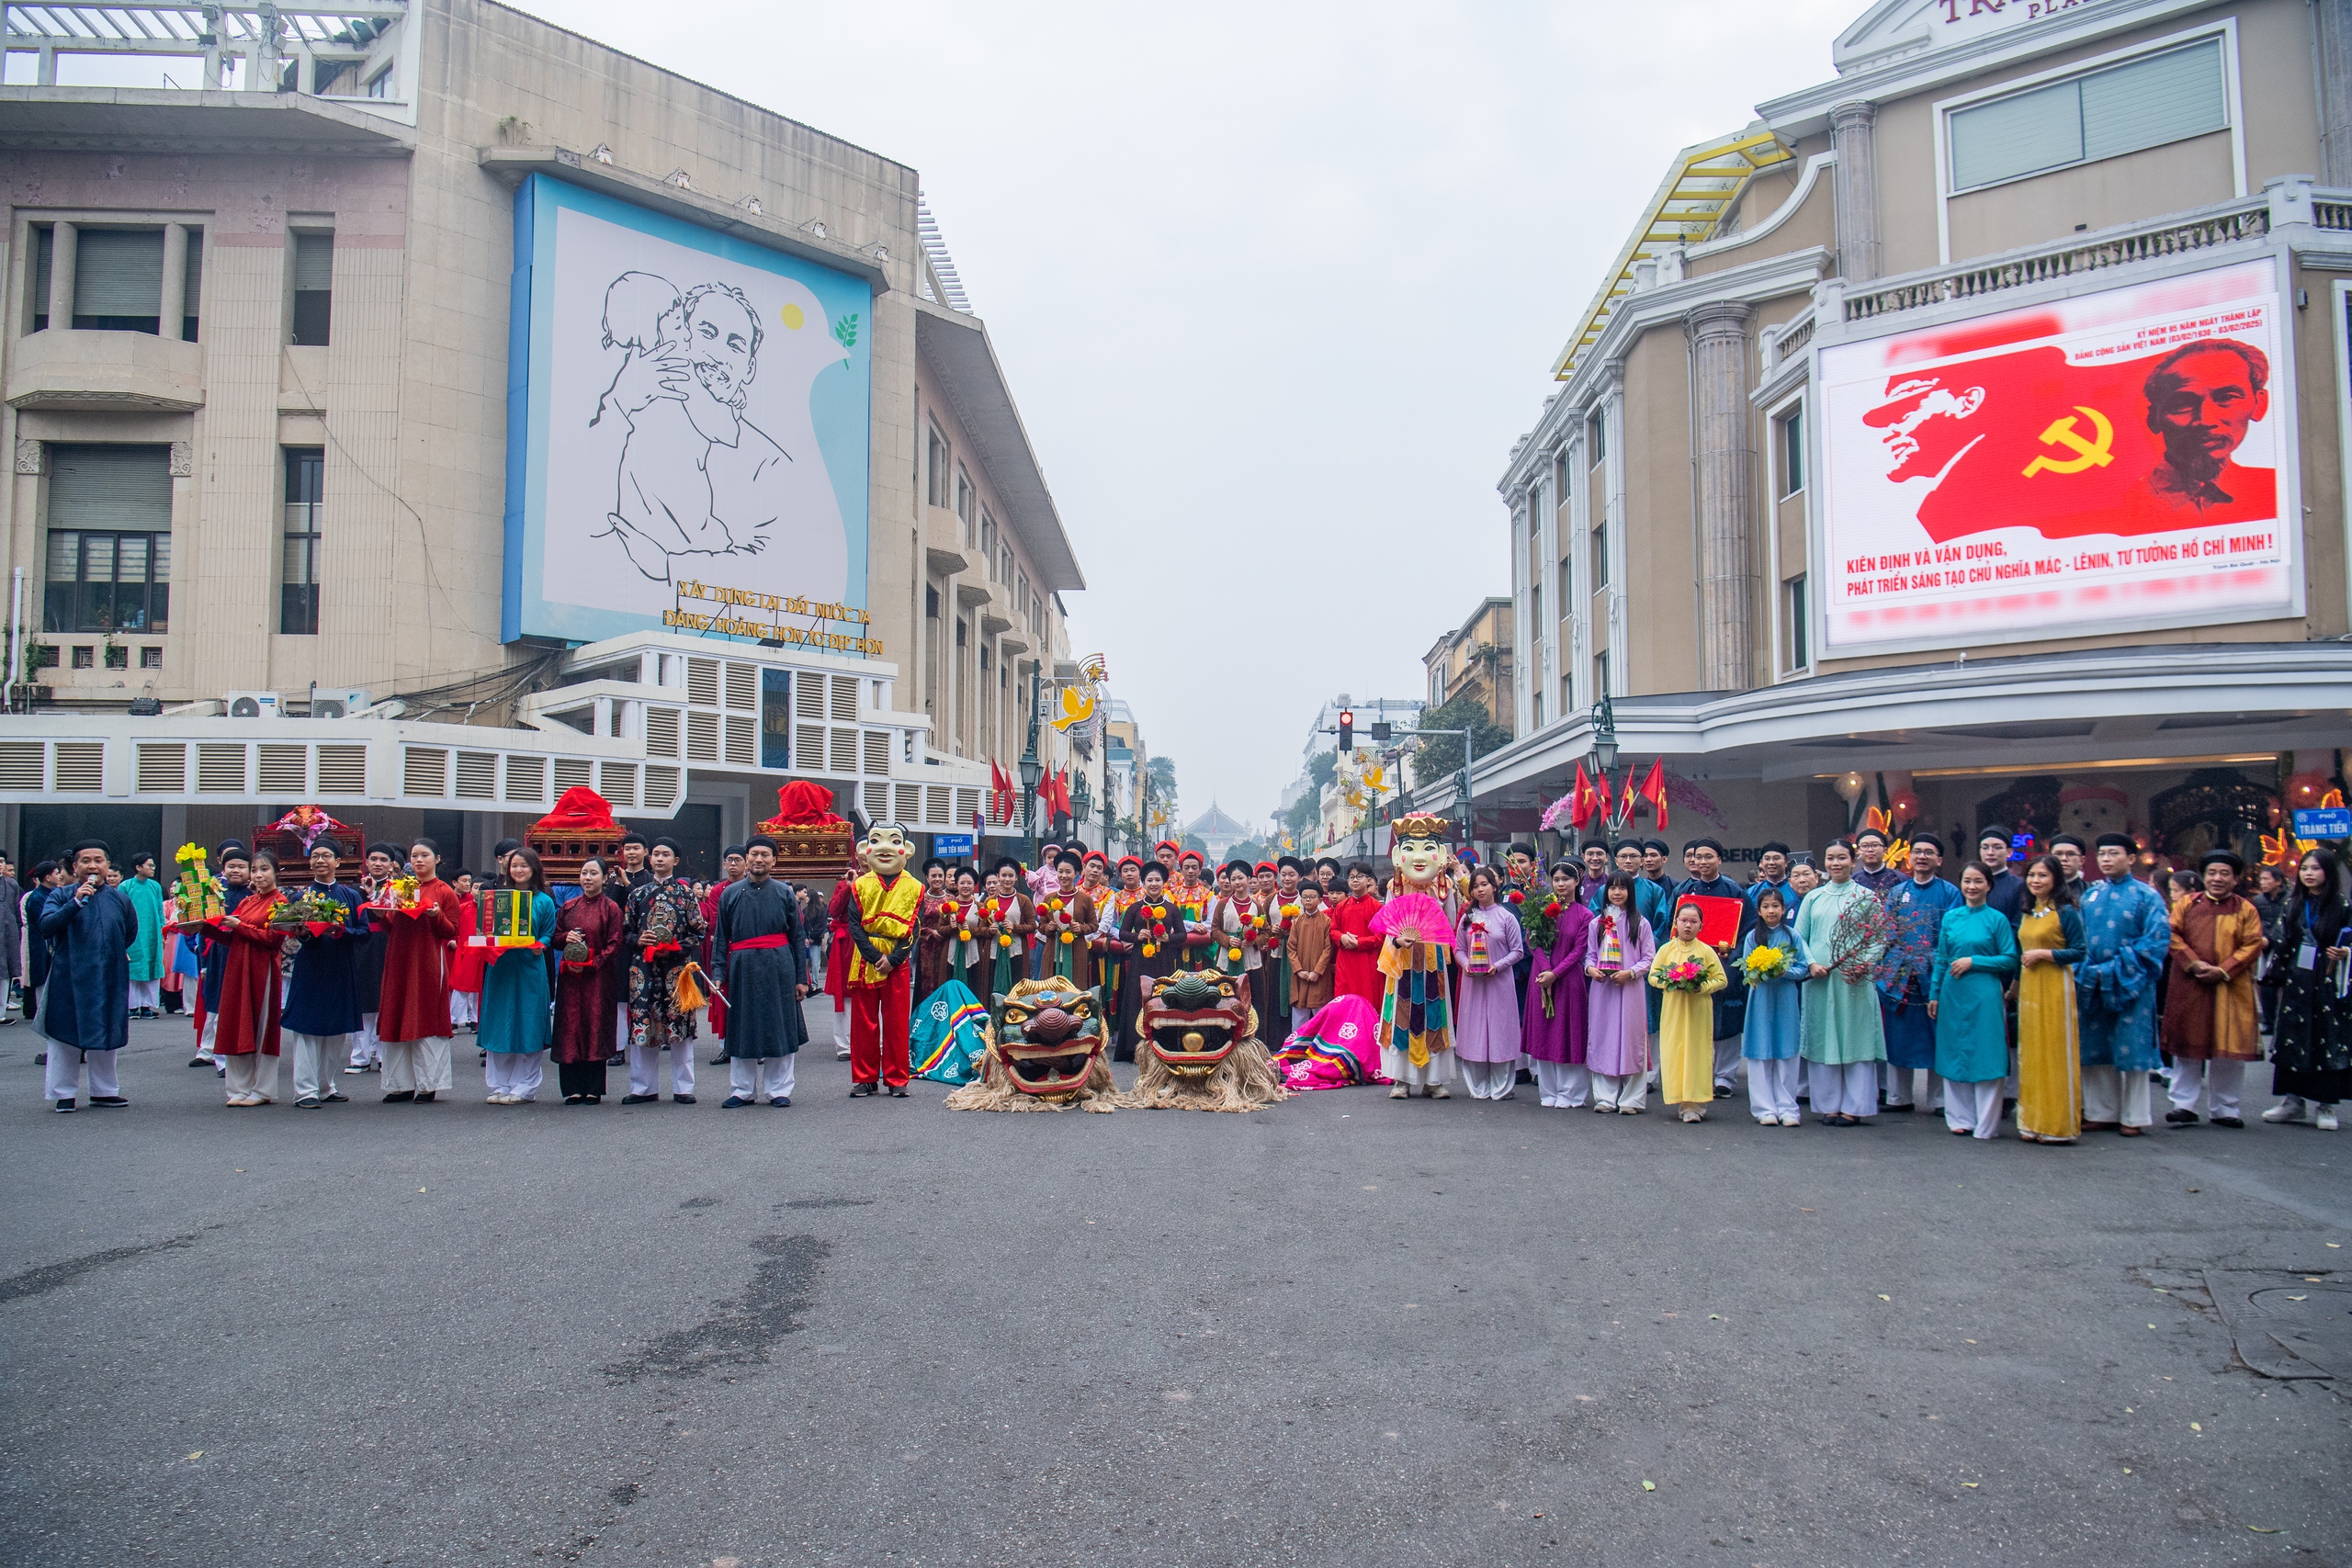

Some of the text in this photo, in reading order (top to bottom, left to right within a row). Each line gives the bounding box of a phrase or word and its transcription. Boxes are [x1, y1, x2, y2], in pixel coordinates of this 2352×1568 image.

[2149, 325, 2167, 338] NIỆM
[2180, 321, 2197, 332] NĂM
[2199, 316, 2220, 328] NGÀY
[2222, 311, 2245, 323] THÀNH
[2247, 309, 2262, 320] LẬP
[2096, 345, 2115, 357] CỘNG
[2117, 342, 2132, 353] SẢN
[2133, 340, 2148, 351] VIỆT
[2150, 336, 2166, 347] NAM
[1847, 541, 2007, 573] KIÊN ĐỊNH VÀ VẬN DỤNG,
[1847, 577, 1873, 596] PHÁT
[1877, 570, 1907, 593] TRIỂN
[1911, 570, 1941, 590] SÁNG
[1945, 569, 1965, 588] TẠO
[1969, 560, 1991, 582] CHỦ
[1996, 559, 2030, 581] NGHĨA
[2035, 556, 2062, 576] MÁC
[2074, 552, 2114, 570] LÊNIN,
[2118, 547, 2133, 566] TƯ
[2136, 540, 2177, 564] TƯỞNG
[2182, 536, 2199, 558] HỒ
[2203, 536, 2224, 556] CHÍ
[2229, 534, 2265, 554] MINH
[679, 579, 871, 625] XÂY DỰNG LẠI ĐẤT NƯỚC TA
[665, 606, 884, 654] ĐÀNG HOÀNG HƠN TO ĐẸP HƠN
[2300, 820, 2347, 835] TRÀNG TIỀN
[2319, 811, 2336, 819] PHỐ
